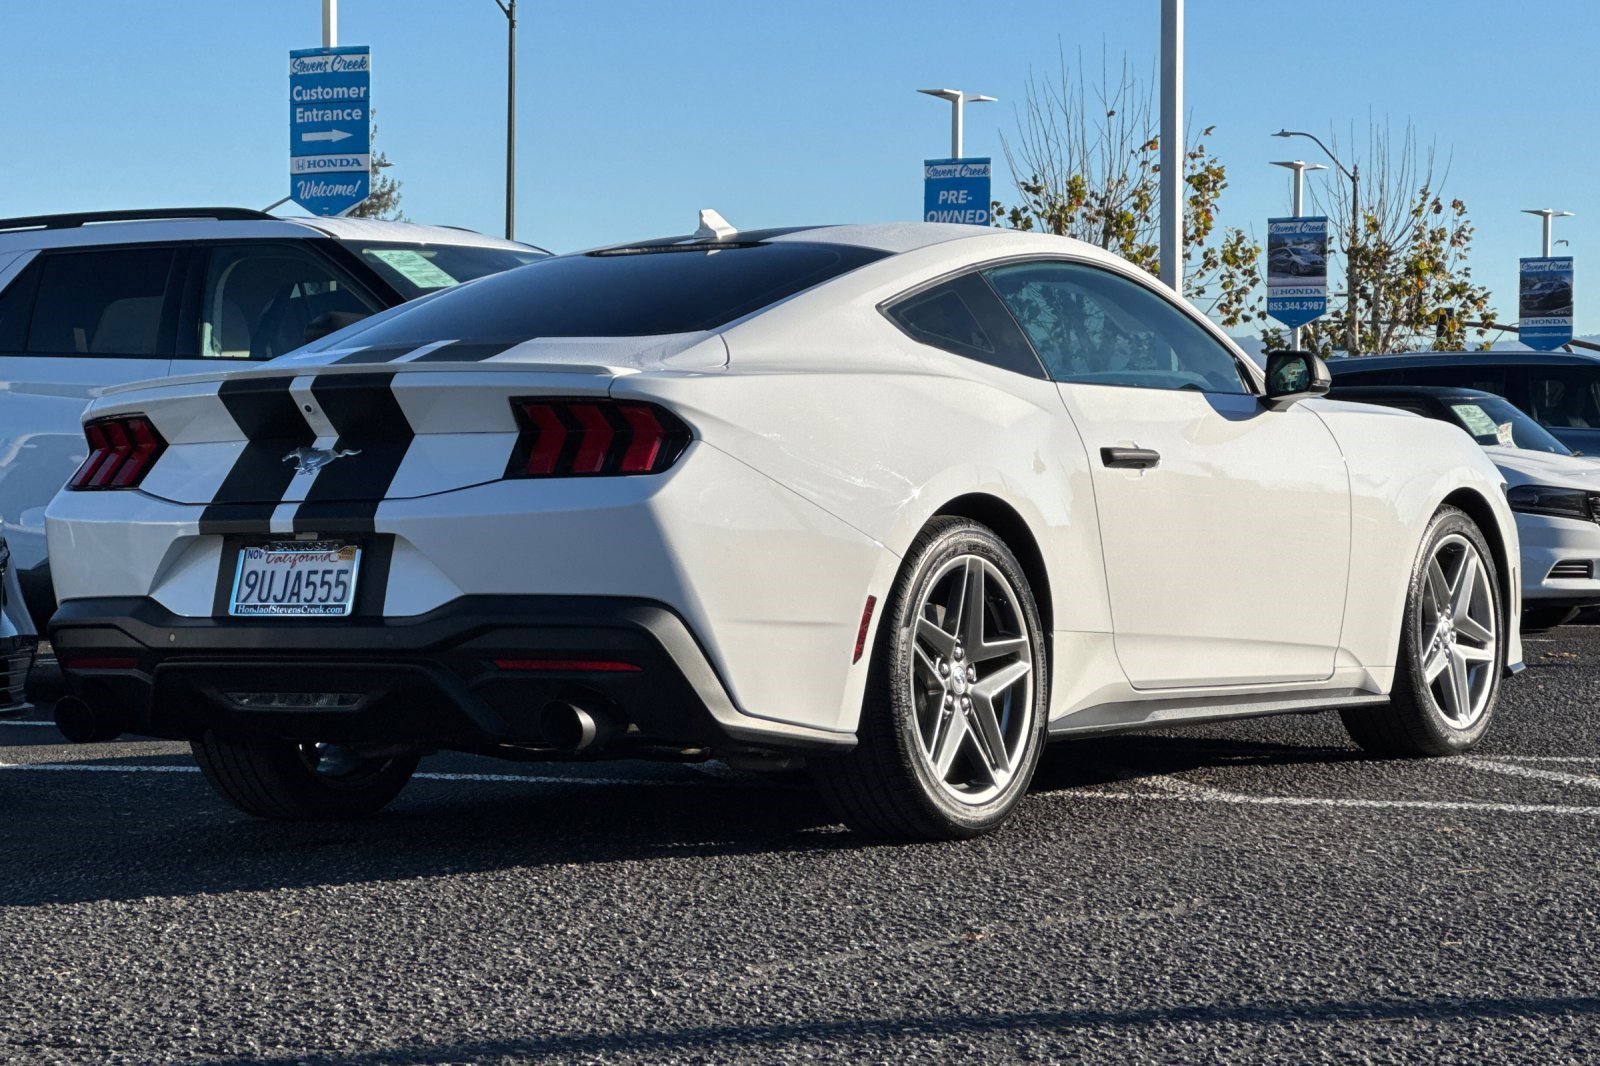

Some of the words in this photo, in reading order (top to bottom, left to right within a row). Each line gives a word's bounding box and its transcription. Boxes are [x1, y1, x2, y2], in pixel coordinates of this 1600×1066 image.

[330, 55, 367, 72] Creek
[293, 86, 366, 101] Customer
[296, 108, 362, 123] Entrance
[307, 157, 362, 169] HONDA
[959, 163, 989, 178] Creek
[297, 180, 361, 200] Welcome!
[938, 189, 973, 205] PRE-
[926, 209, 988, 224] OWNED
[1300, 221, 1326, 234] Creek
[1280, 288, 1322, 296] HONDA
[1268, 300, 1324, 311] 855.344.2987
[247, 550, 262, 560] NOV
[266, 552, 338, 569] California
[241, 569, 349, 603] 9UJA555
[238, 604, 343, 615] HondaofStevensCreek.com
